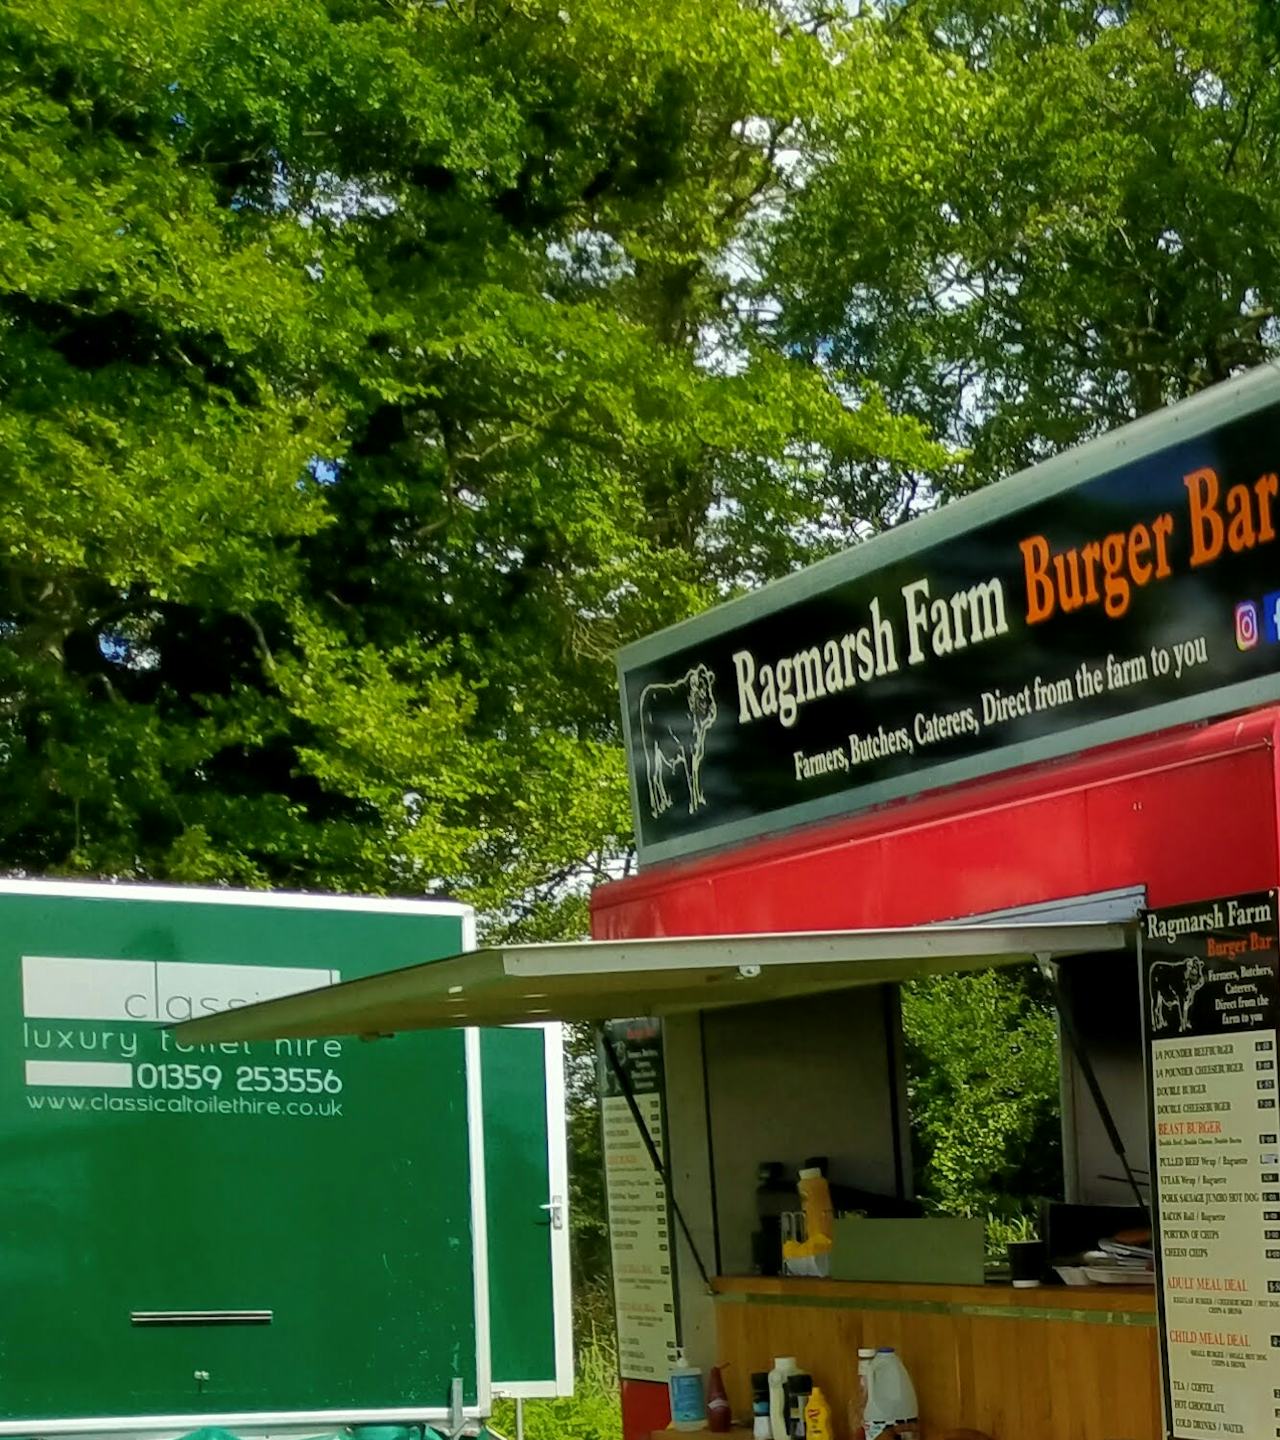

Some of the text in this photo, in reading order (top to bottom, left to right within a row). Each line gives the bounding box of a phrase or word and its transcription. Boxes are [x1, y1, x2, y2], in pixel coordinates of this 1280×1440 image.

[732, 466, 1279, 727] Ragmarsh Farm Burger Bar
[793, 636, 1209, 781] Farmers, Butchers, Caterers, Direct from the farm to you
[1147, 900, 1272, 944] Ragmarsh Farm
[1207, 932, 1273, 961] Burger Bar
[24, 1022, 138, 1058] luxury
[137, 1063, 343, 1093] 01359 253556
[26, 1093, 344, 1117] www.classicaltoilethire.co.uk
[1158, 1120, 1221, 1135] BEAST BURGER
[1167, 1277, 1247, 1292] ADULT MEAL DEAL
[1169, 1330, 1250, 1348] CHILD MEAL DEAL
[1172, 1381, 1185, 1391] TEA
[1190, 1381, 1215, 1394] COFFEE
[1174, 1400, 1225, 1414] HOT CHOCOLATE
[1175, 1419, 1191, 1429] COLD
[1192, 1420, 1216, 1432] DRINKS
[1222, 1423, 1245, 1434] WATER
